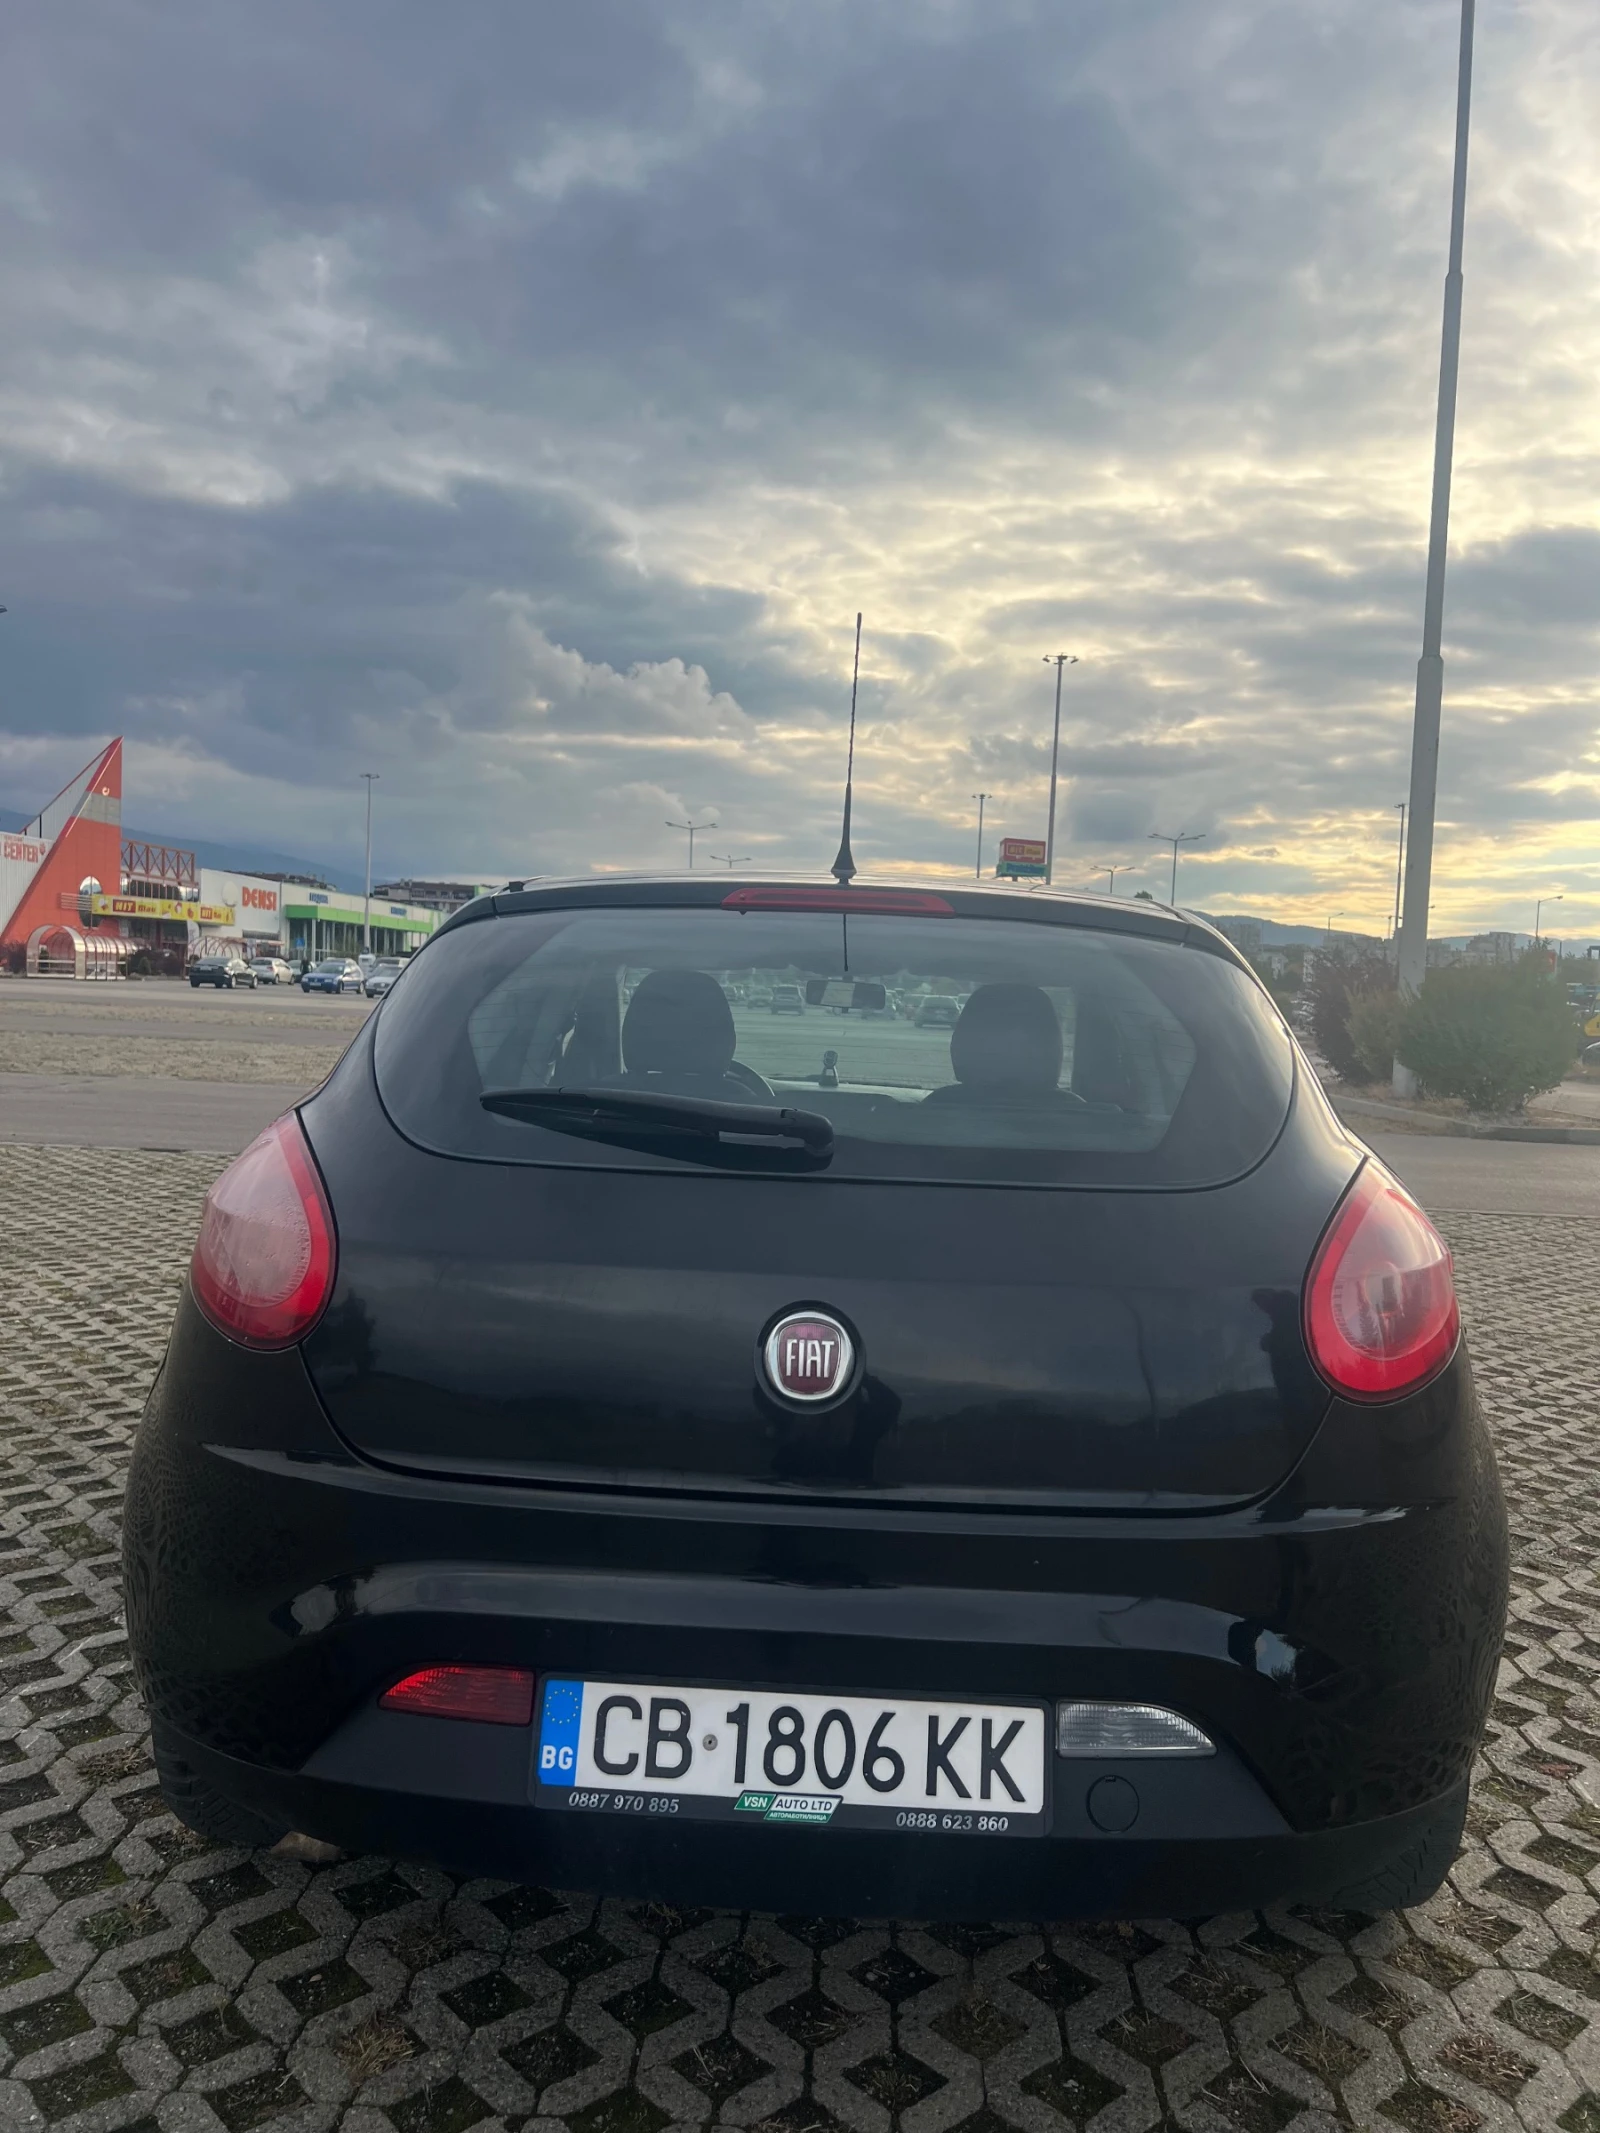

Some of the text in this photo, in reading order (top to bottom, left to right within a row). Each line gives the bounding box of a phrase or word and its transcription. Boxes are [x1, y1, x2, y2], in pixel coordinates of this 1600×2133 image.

[4, 842, 38, 863] CENTER
[115, 901, 133, 911] HIT
[242, 886, 277, 911] DENSI
[786, 1339, 834, 1378] FIAT
[541, 1745, 573, 1770] BG
[593, 1695, 1026, 1802] CB 1806 KK
[568, 1791, 680, 1814] 0887 970 895
[743, 1796, 833, 1811] VSN AUTO LTD
[895, 1812, 1009, 1832] 0888 623 860
